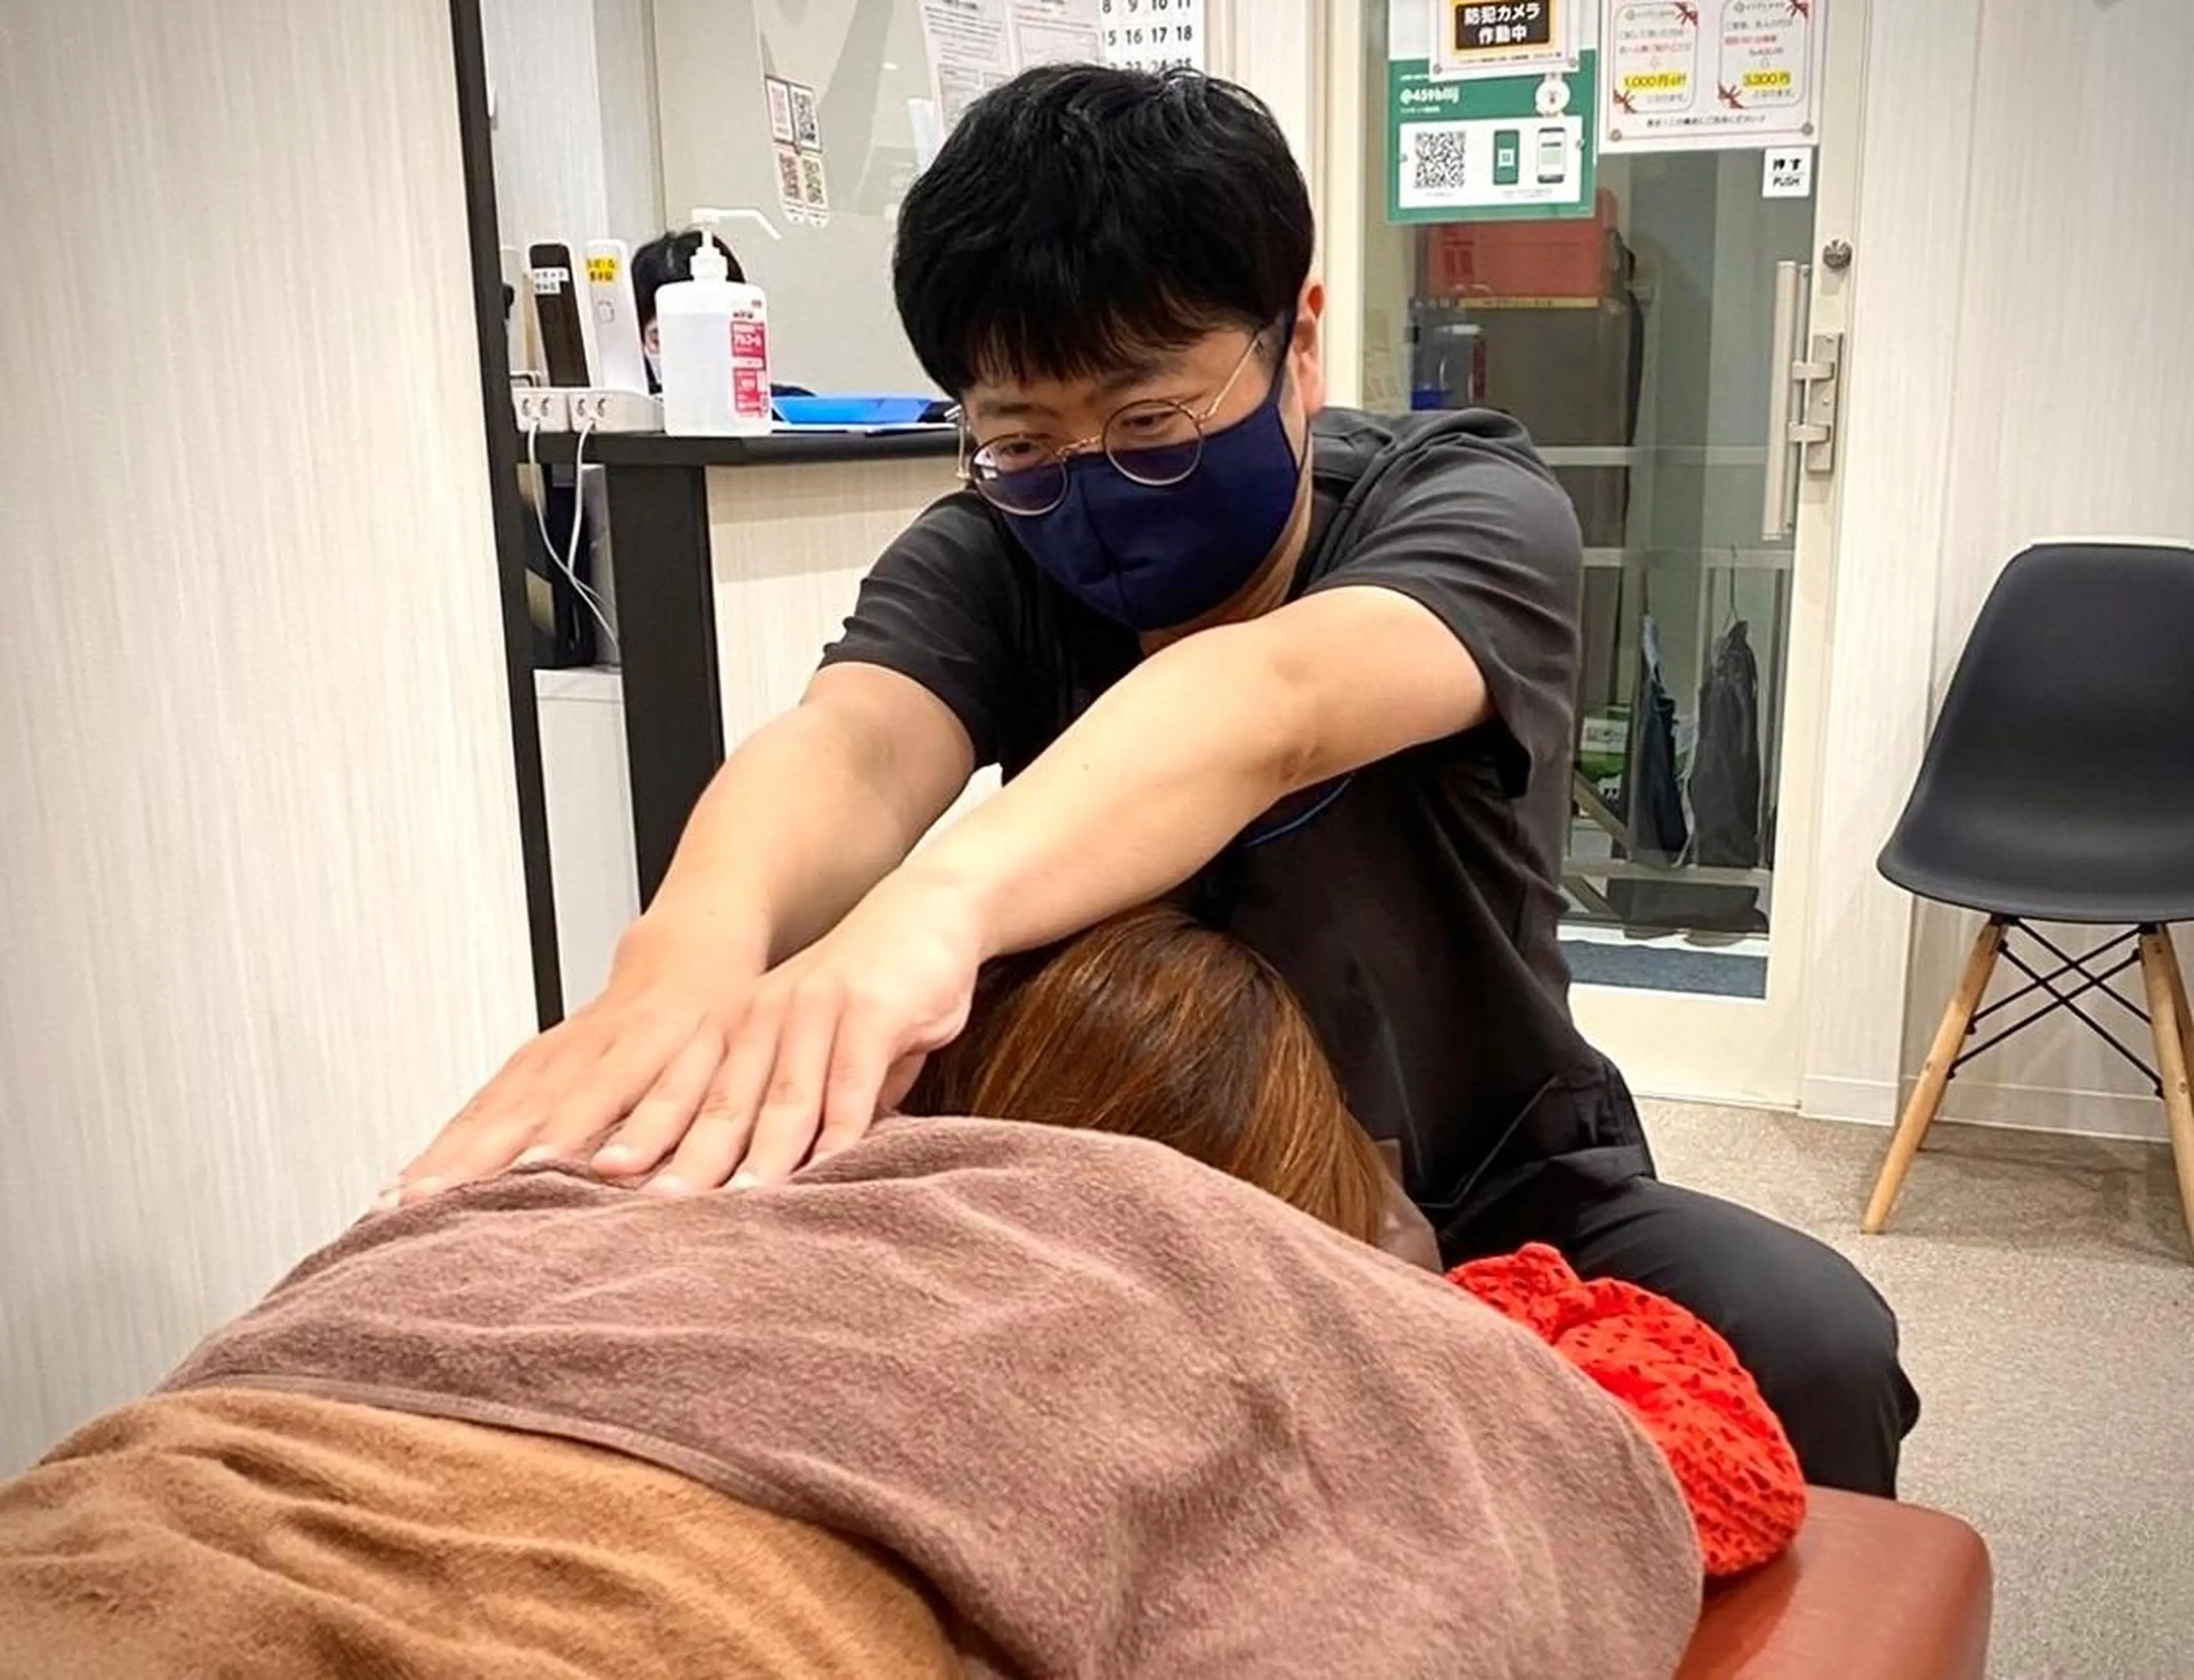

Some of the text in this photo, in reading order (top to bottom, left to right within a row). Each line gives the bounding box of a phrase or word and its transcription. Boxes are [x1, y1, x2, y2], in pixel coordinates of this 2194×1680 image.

[1102, 0, 1112, 13] 8
[1127, 0, 1139, 13] 9
[1464, 3, 1541, 26] 防犯カメラ
[1126, 29, 1143, 45] 16
[1151, 27, 1167, 43] 17
[1176, 25, 1192, 41] 18
[1478, 24, 1527, 45] 作動中
